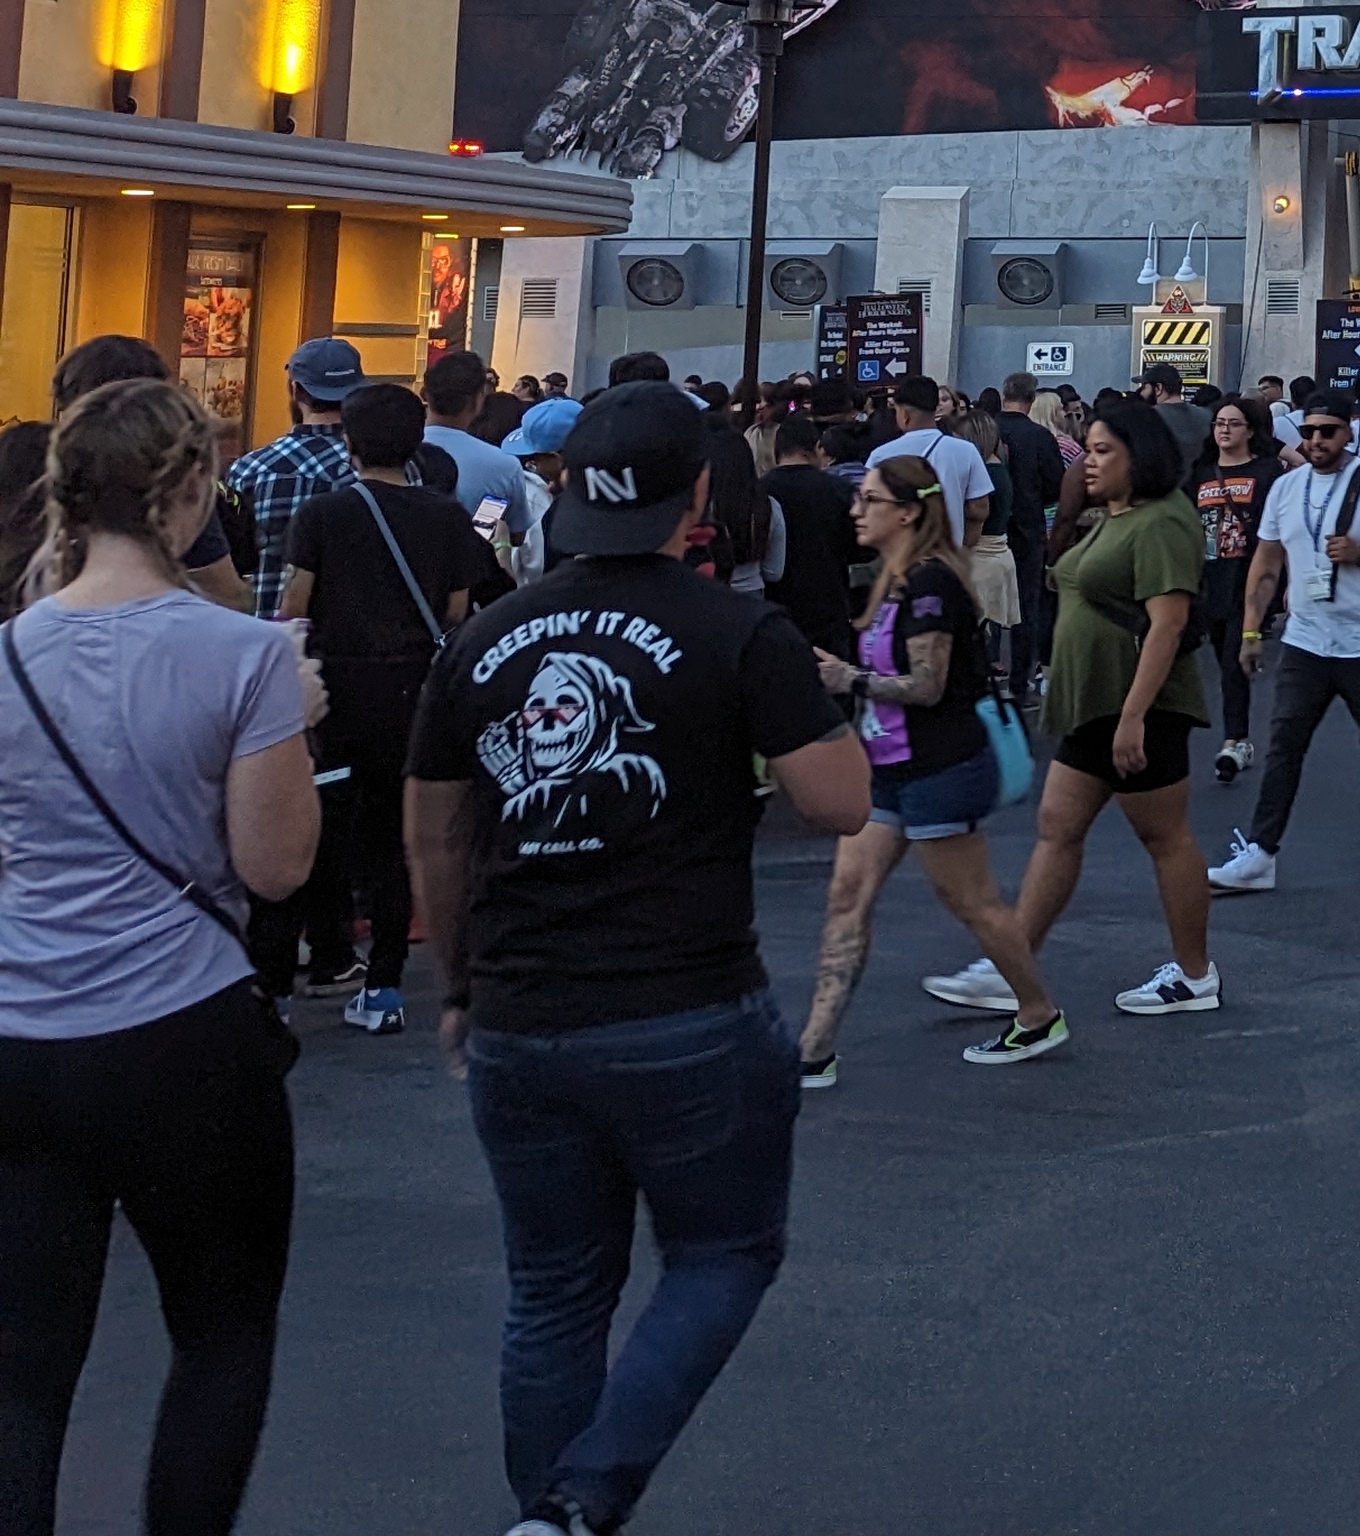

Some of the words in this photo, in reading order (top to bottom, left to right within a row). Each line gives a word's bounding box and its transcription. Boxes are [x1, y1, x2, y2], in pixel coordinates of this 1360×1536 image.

[1340, 318, 1354, 327] The
[1322, 329, 1341, 339] After
[1156, 352, 1198, 362] WARNING
[1033, 363, 1066, 372] ENTRANCE
[1338, 366, 1358, 376] Killer
[1329, 378, 1349, 388] From
[472, 610, 592, 685] CREEPIN'
[595, 611, 626, 636] IT
[621, 616, 683, 676] REAL
